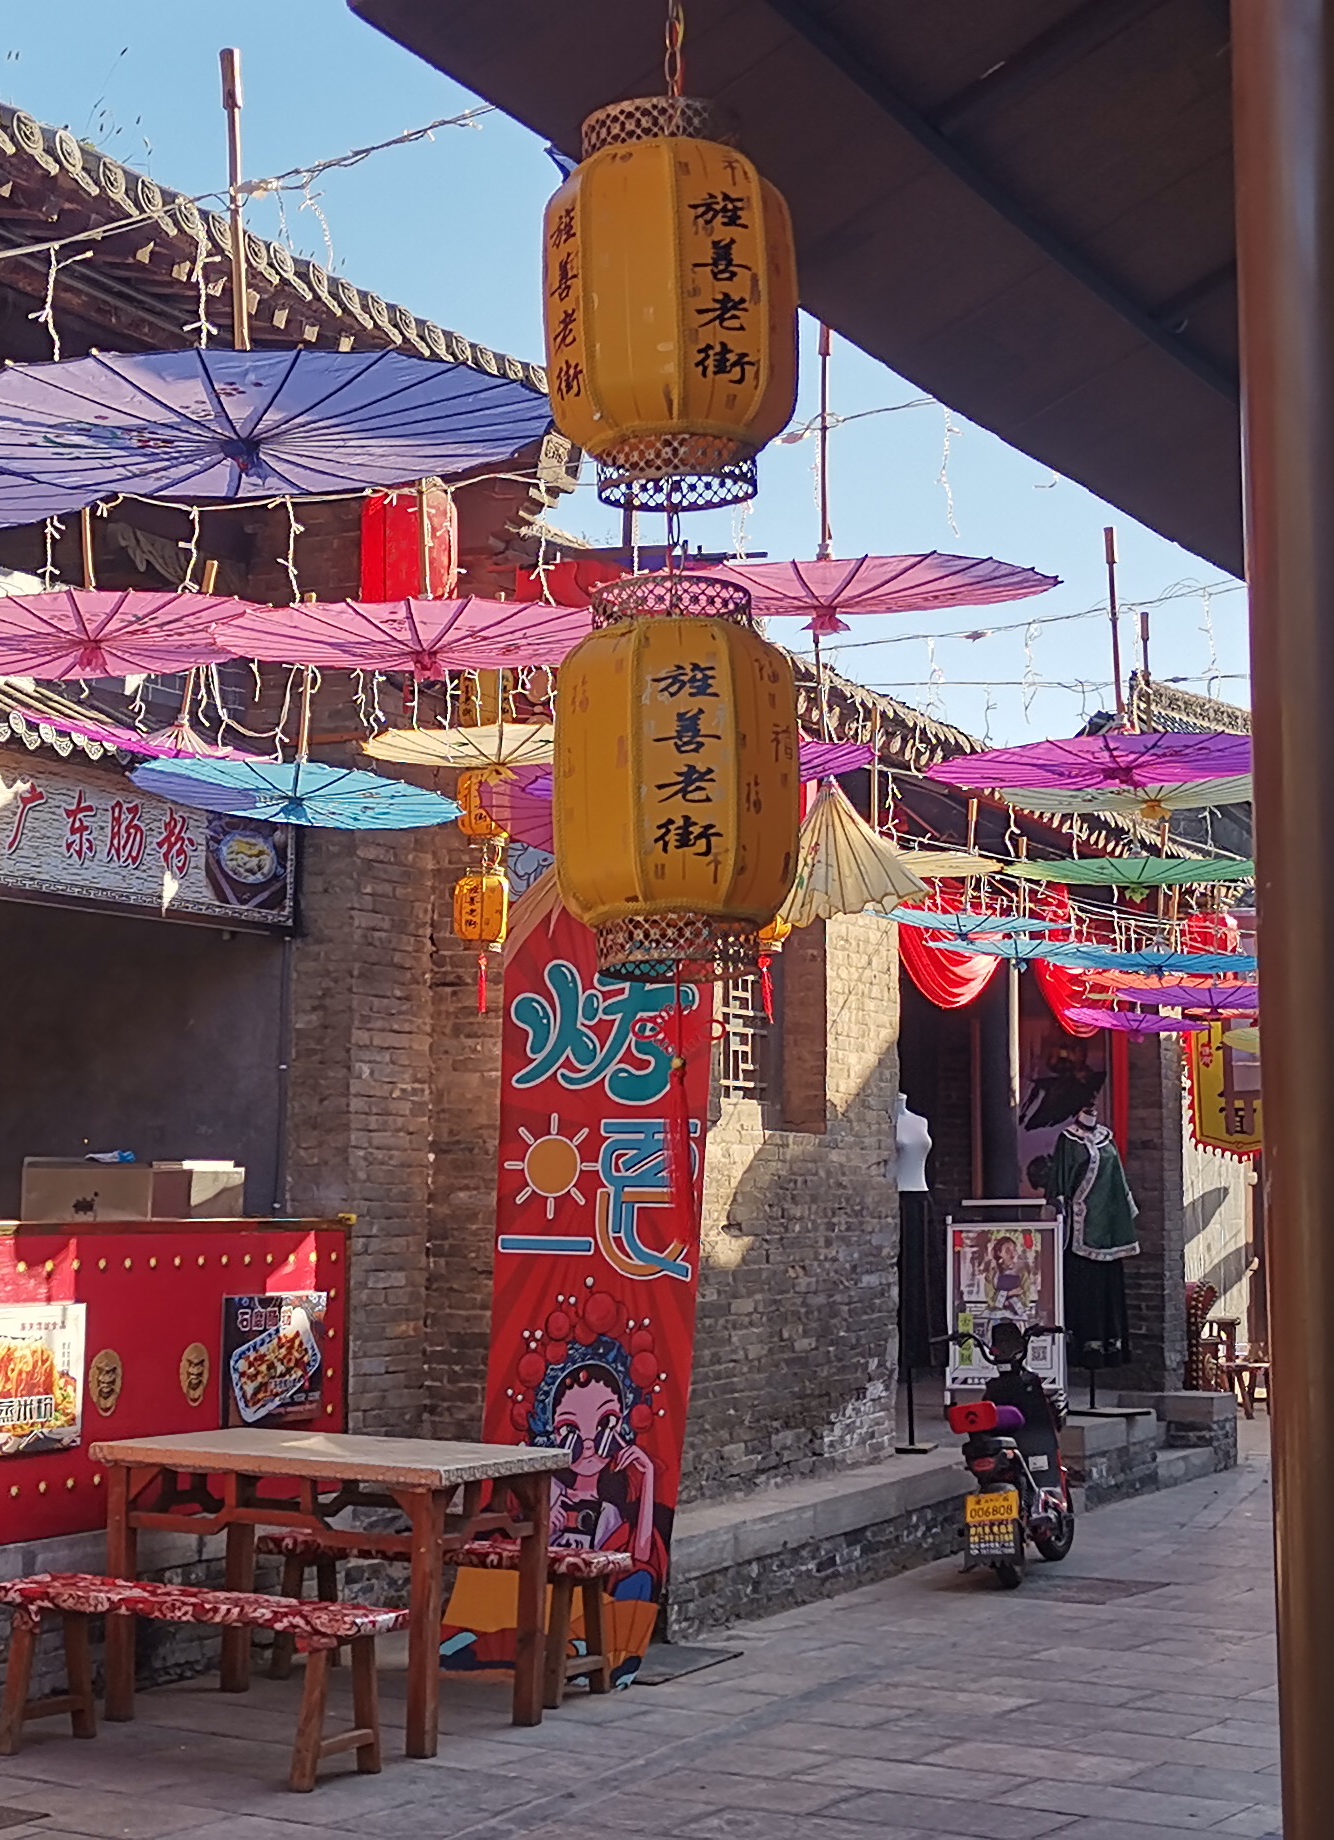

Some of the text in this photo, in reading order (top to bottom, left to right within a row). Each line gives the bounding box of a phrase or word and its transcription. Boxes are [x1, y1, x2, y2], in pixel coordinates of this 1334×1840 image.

[688, 191, 757, 384] 旌善老街
[7, 781, 197, 878] 广东肠粉
[652, 662, 723, 857] 旌善老街
